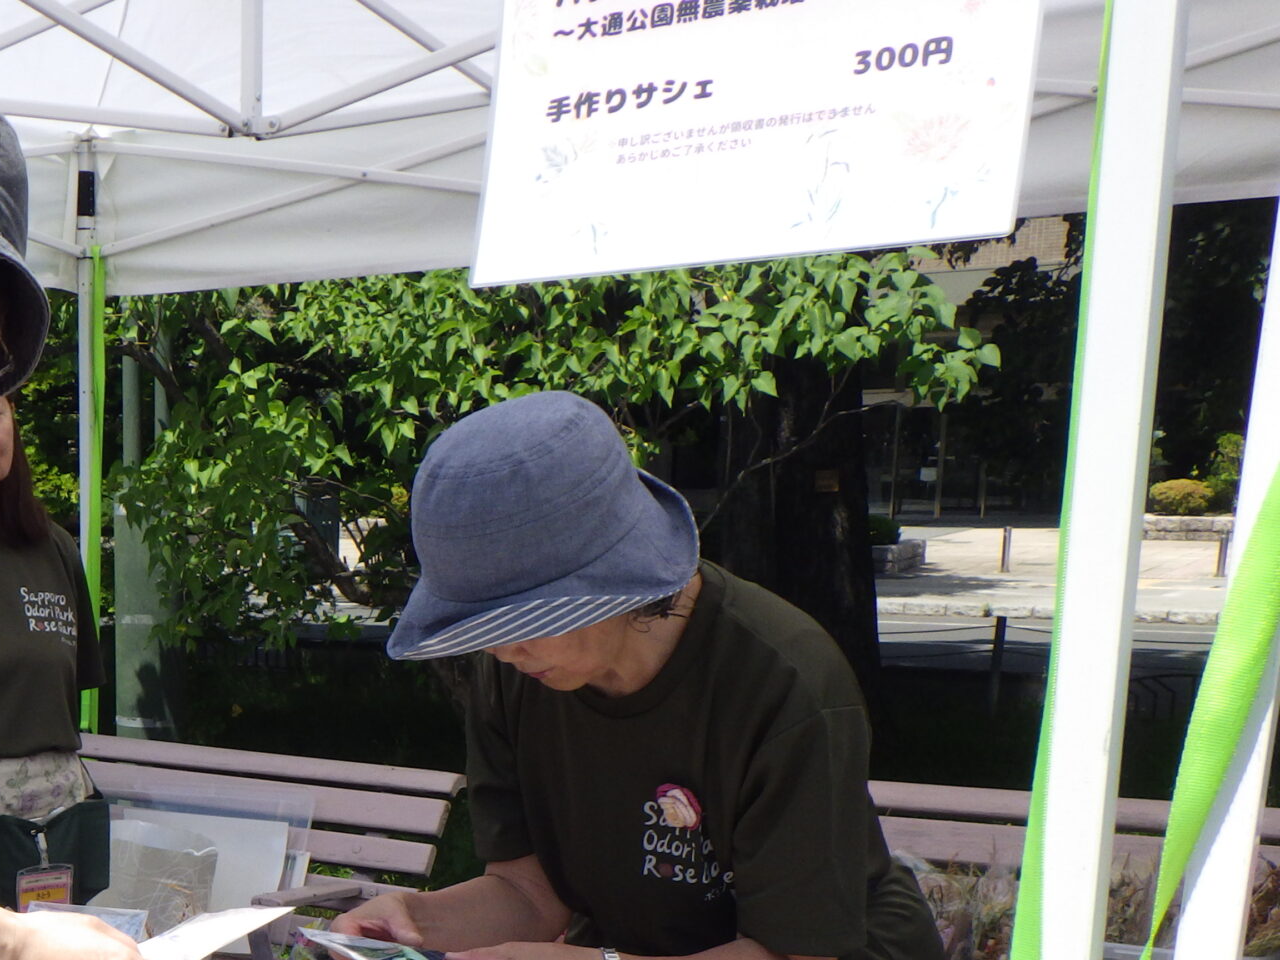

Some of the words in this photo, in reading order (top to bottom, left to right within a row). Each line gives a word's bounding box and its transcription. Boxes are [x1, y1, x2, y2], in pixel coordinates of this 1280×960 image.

[852, 36, 954, 76] 300円
[545, 78, 714, 123] 手作りサシェ
[615, 136, 752, 166] あらかじめご了承ください
[20, 587, 66, 605] Sapporo
[24, 604, 54, 618] Odori
[643, 829, 696, 862] Odori
